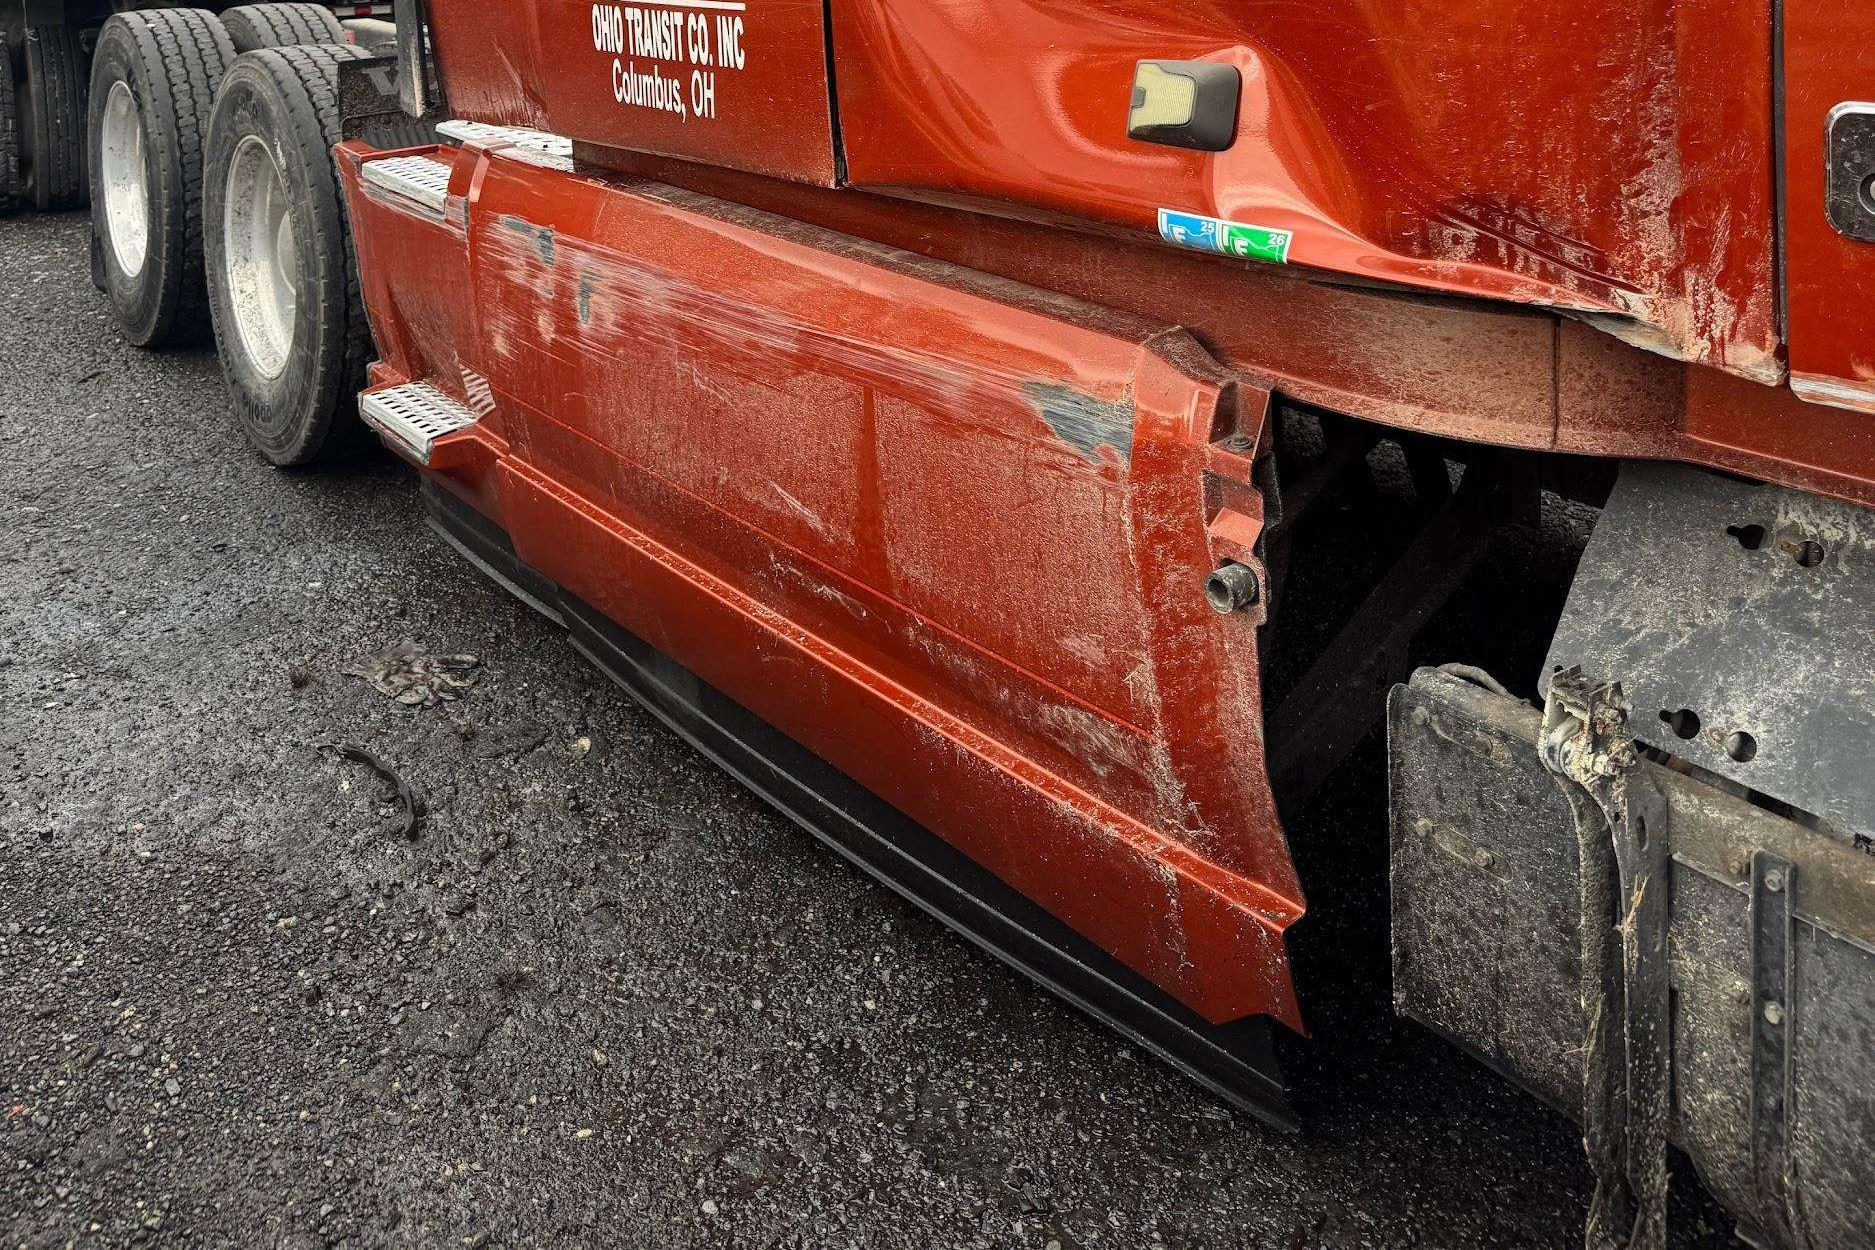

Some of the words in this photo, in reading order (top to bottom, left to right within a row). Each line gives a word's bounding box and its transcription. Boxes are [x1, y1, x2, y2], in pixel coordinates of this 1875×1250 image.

[591, 3, 624, 54] OHIO
[624, 7, 684, 62] TRANSIT
[687, 12, 714, 67] CO.
[716, 15, 745, 70] INC
[612, 58, 686, 123] Columbus,
[690, 69, 716, 119] OH
[1200, 220, 1216, 234] 25
[1267, 233, 1286, 246] 26
